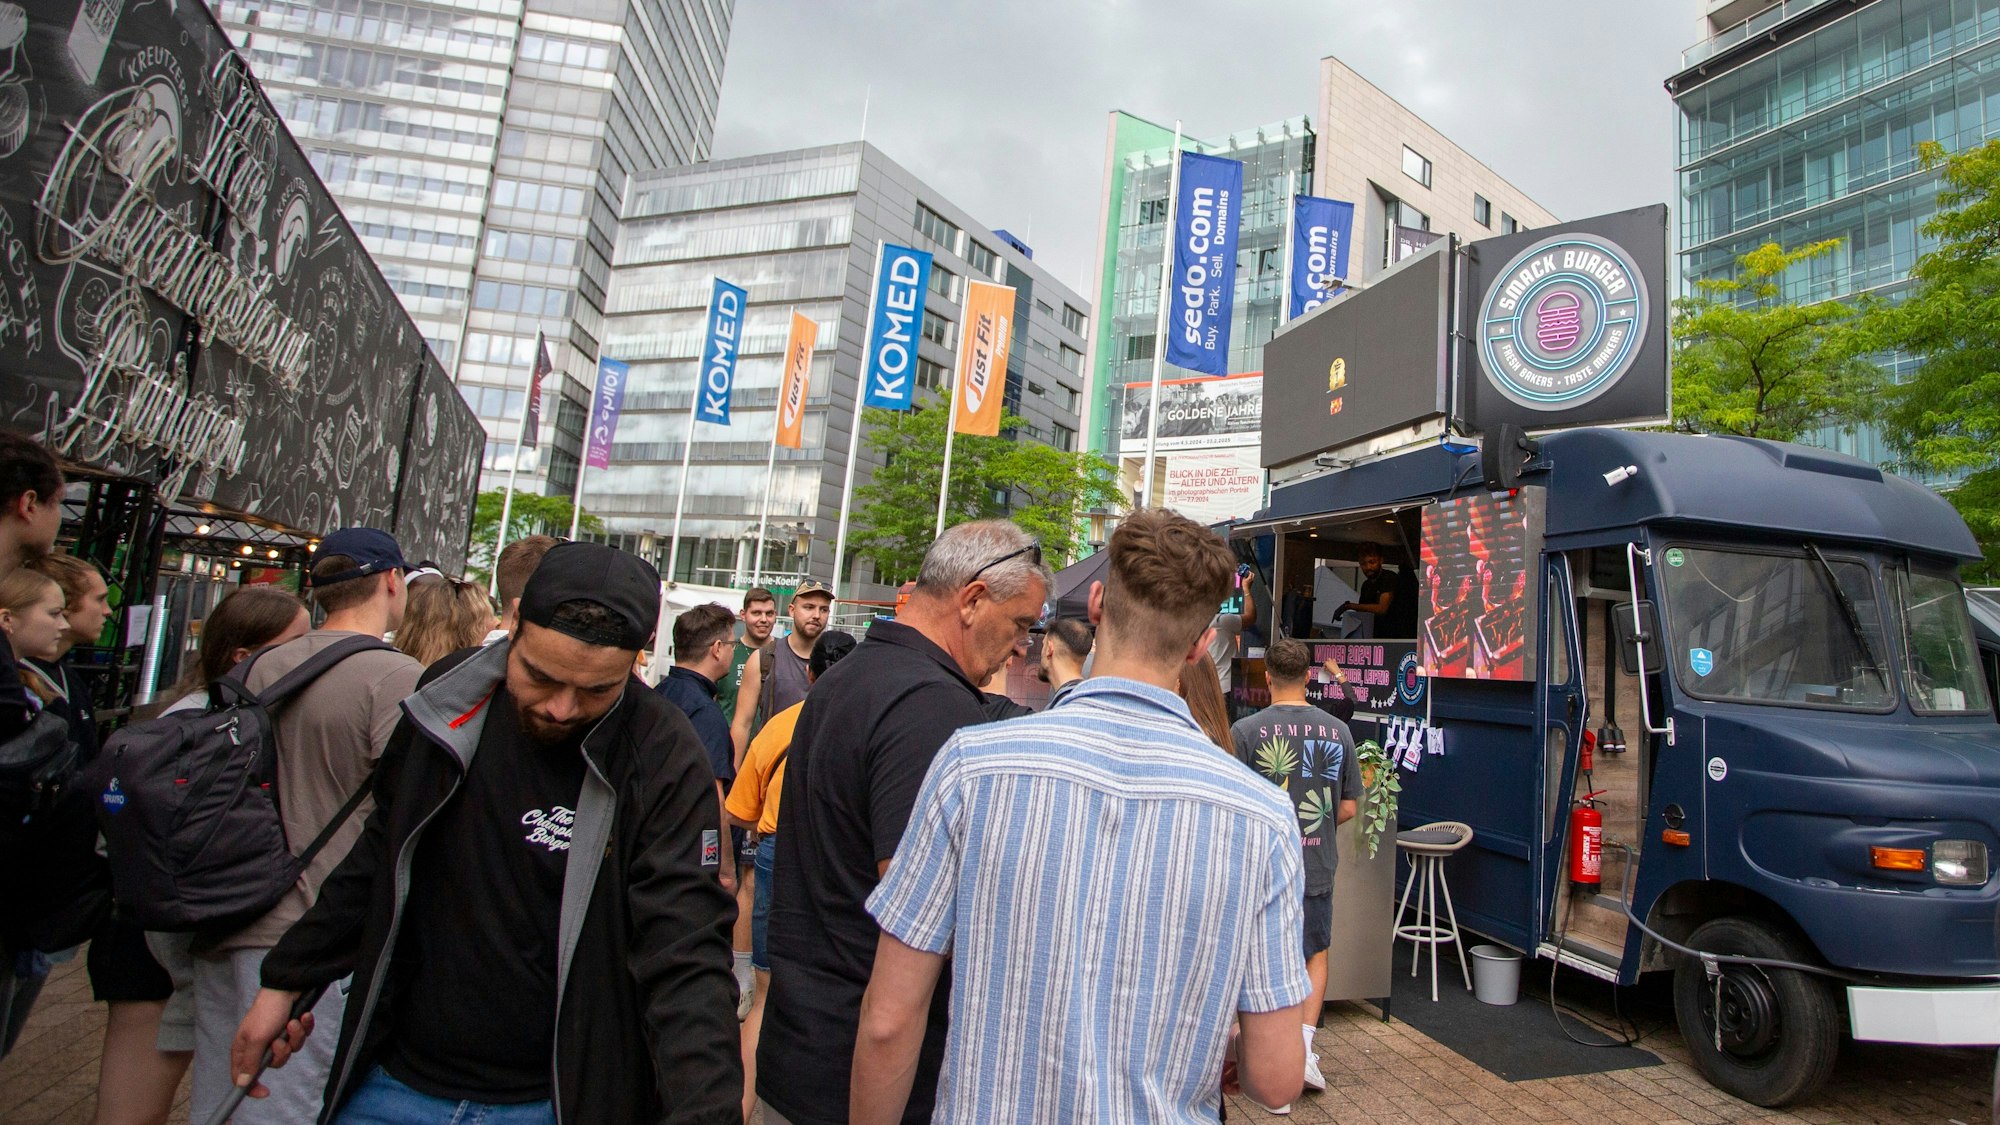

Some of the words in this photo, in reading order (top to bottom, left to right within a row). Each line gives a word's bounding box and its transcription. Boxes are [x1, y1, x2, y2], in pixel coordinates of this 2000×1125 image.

[1213, 189, 1229, 245] Domains
[1328, 229, 1339, 278] omains
[1416, 240, 1428, 249] HA
[1181, 187, 1214, 347] sedo.com
[1211, 252, 1224, 278] Sell.
[1303, 225, 1328, 313] o.com
[1499, 253, 1557, 312] SMACK
[1563, 249, 1627, 296] BURGER
[1207, 285, 1221, 316] Park.
[874, 255, 920, 400] KOMED
[977, 313, 992, 346] Fit
[1204, 325, 1218, 350] Buy.
[704, 290, 738, 417] KOMED
[1501, 344, 1521, 373] FRESH
[1518, 366, 1553, 388] BAKERS
[1563, 366, 1594, 387] TASTE
[1593, 329, 1623, 369] MAKERS
[967, 347, 988, 401] Just
[786, 374, 803, 419] Just
[1167, 407, 1225, 421] GOLDENE
[1226, 404, 1262, 419] JAHRE
[1169, 469, 1194, 479] BLICK
[1195, 469, 1203, 478] IN
[1205, 468, 1219, 477] DIE
[1220, 467, 1239, 476] ZEIT
[1180, 477, 1206, 487] ALTER
[1207, 477, 1226, 486] UND
[1227, 475, 1259, 486] ALTERN
[1176, 487, 1229, 497] photographischen
[1229, 486, 1249, 494] Porträt
[1314, 644, 1346, 664] WINNER
[1347, 645, 1372, 666] 2024
[1364, 668, 1390, 686] LEIPZIG
[1259, 723, 1340, 740] SEMPRE
[521, 809, 573, 838] Champi
[549, 805, 576, 825] The
[525, 827, 571, 851] Burge
